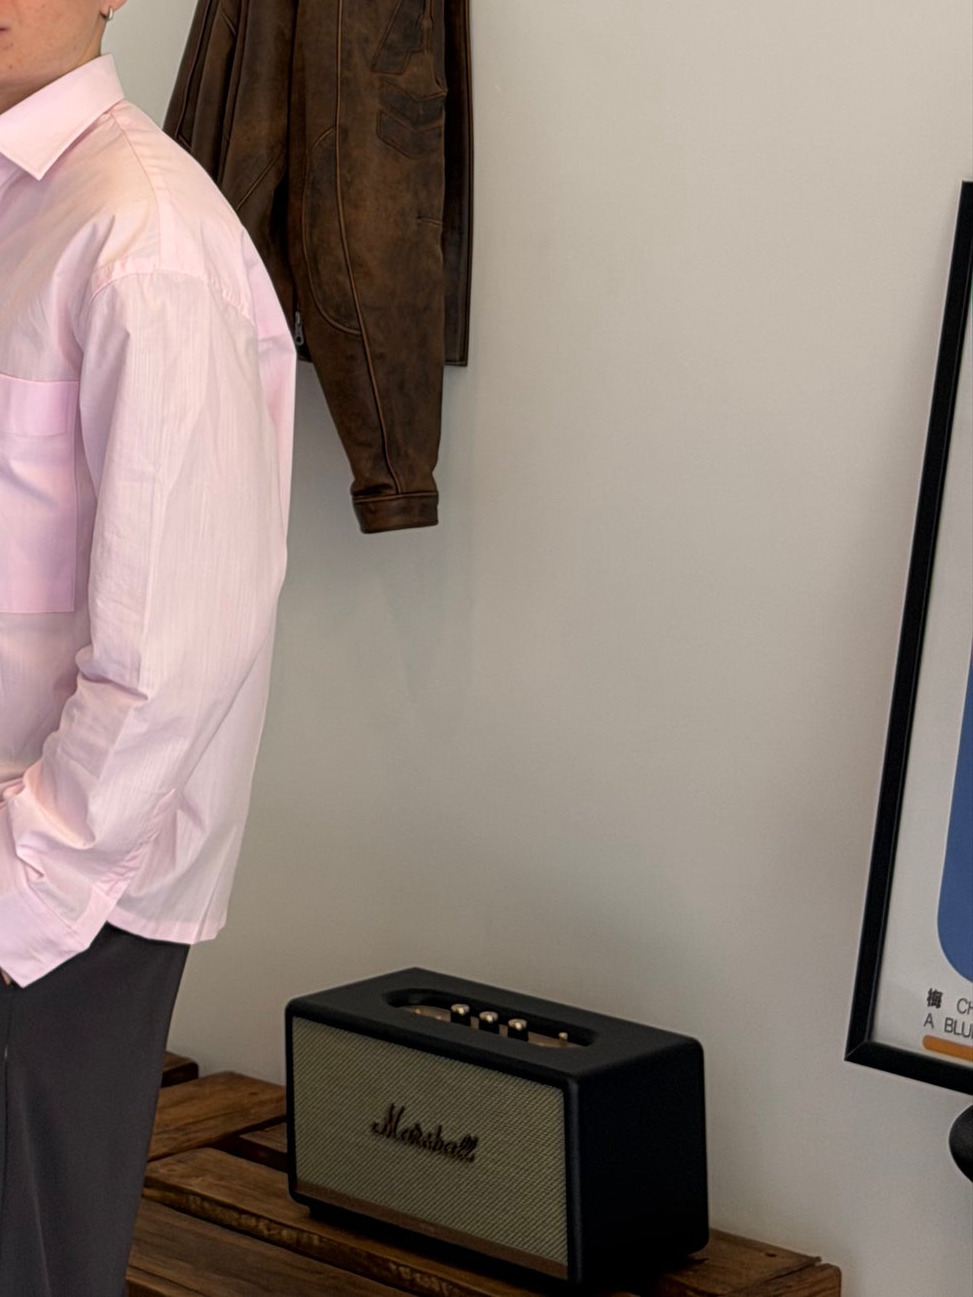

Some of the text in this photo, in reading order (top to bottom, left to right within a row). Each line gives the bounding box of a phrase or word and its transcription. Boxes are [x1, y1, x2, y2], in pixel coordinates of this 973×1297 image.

[923, 1013, 973, 1039] A BLU
[371, 1103, 479, 1162] Marshall
